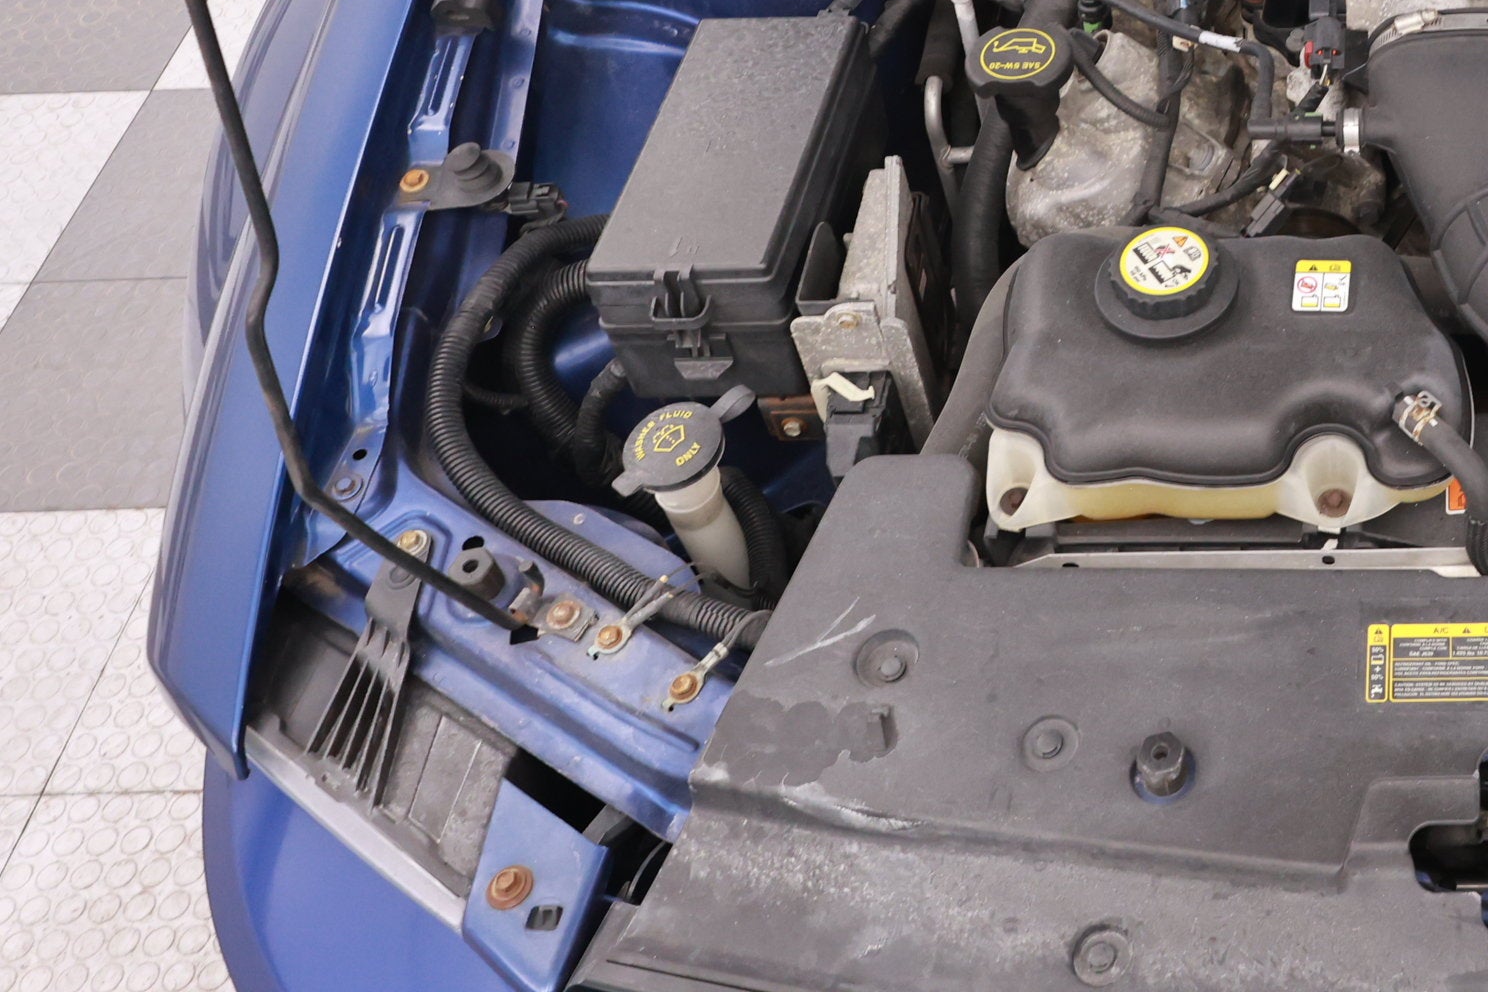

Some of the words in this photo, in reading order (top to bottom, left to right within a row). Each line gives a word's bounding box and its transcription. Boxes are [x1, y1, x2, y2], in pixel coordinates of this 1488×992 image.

[988, 61, 1020, 70] 5W-20
[1021, 61, 1042, 70] SAE
[634, 421, 656, 462] WASHER
[659, 409, 693, 421] FLUID
[675, 442, 702, 467] ONLY
